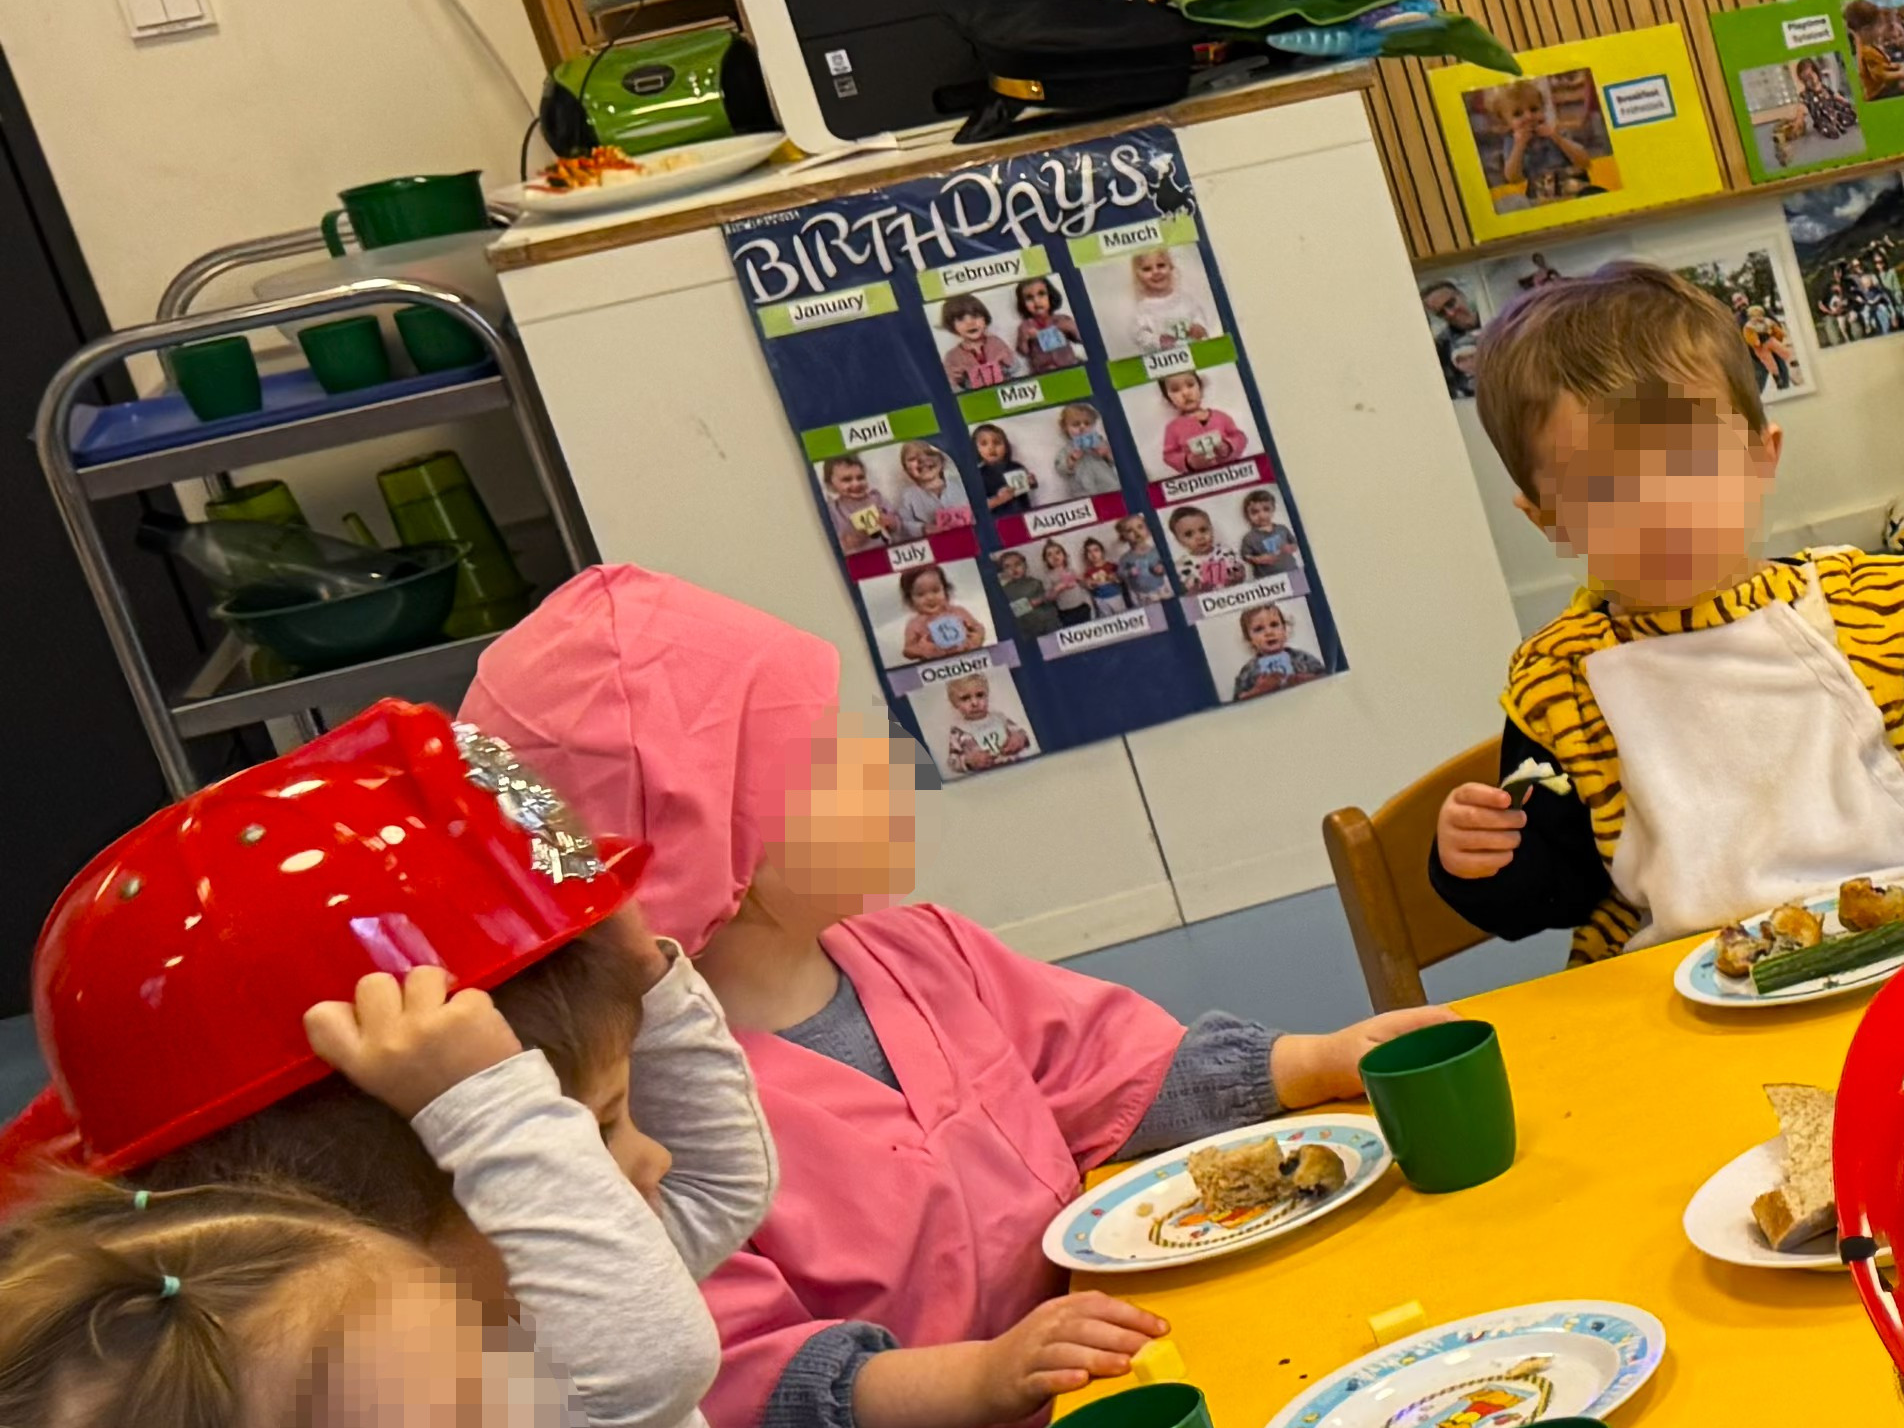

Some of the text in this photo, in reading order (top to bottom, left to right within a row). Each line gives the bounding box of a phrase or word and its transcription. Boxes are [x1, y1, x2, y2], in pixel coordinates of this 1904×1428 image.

[733, 144, 1149, 304] BIRTHDAYS
[1103, 225, 1159, 248] March
[943, 256, 1021, 286] February
[794, 294, 865, 321] January
[1148, 348, 1189, 370] June
[1001, 384, 1038, 402] May
[849, 422, 889, 444] April
[1165, 463, 1255, 496] September
[1032, 504, 1093, 530] August
[892, 546, 926, 566] July
[1203, 579, 1287, 612] December
[1059, 613, 1145, 646] November
[921, 655, 989, 683] October
